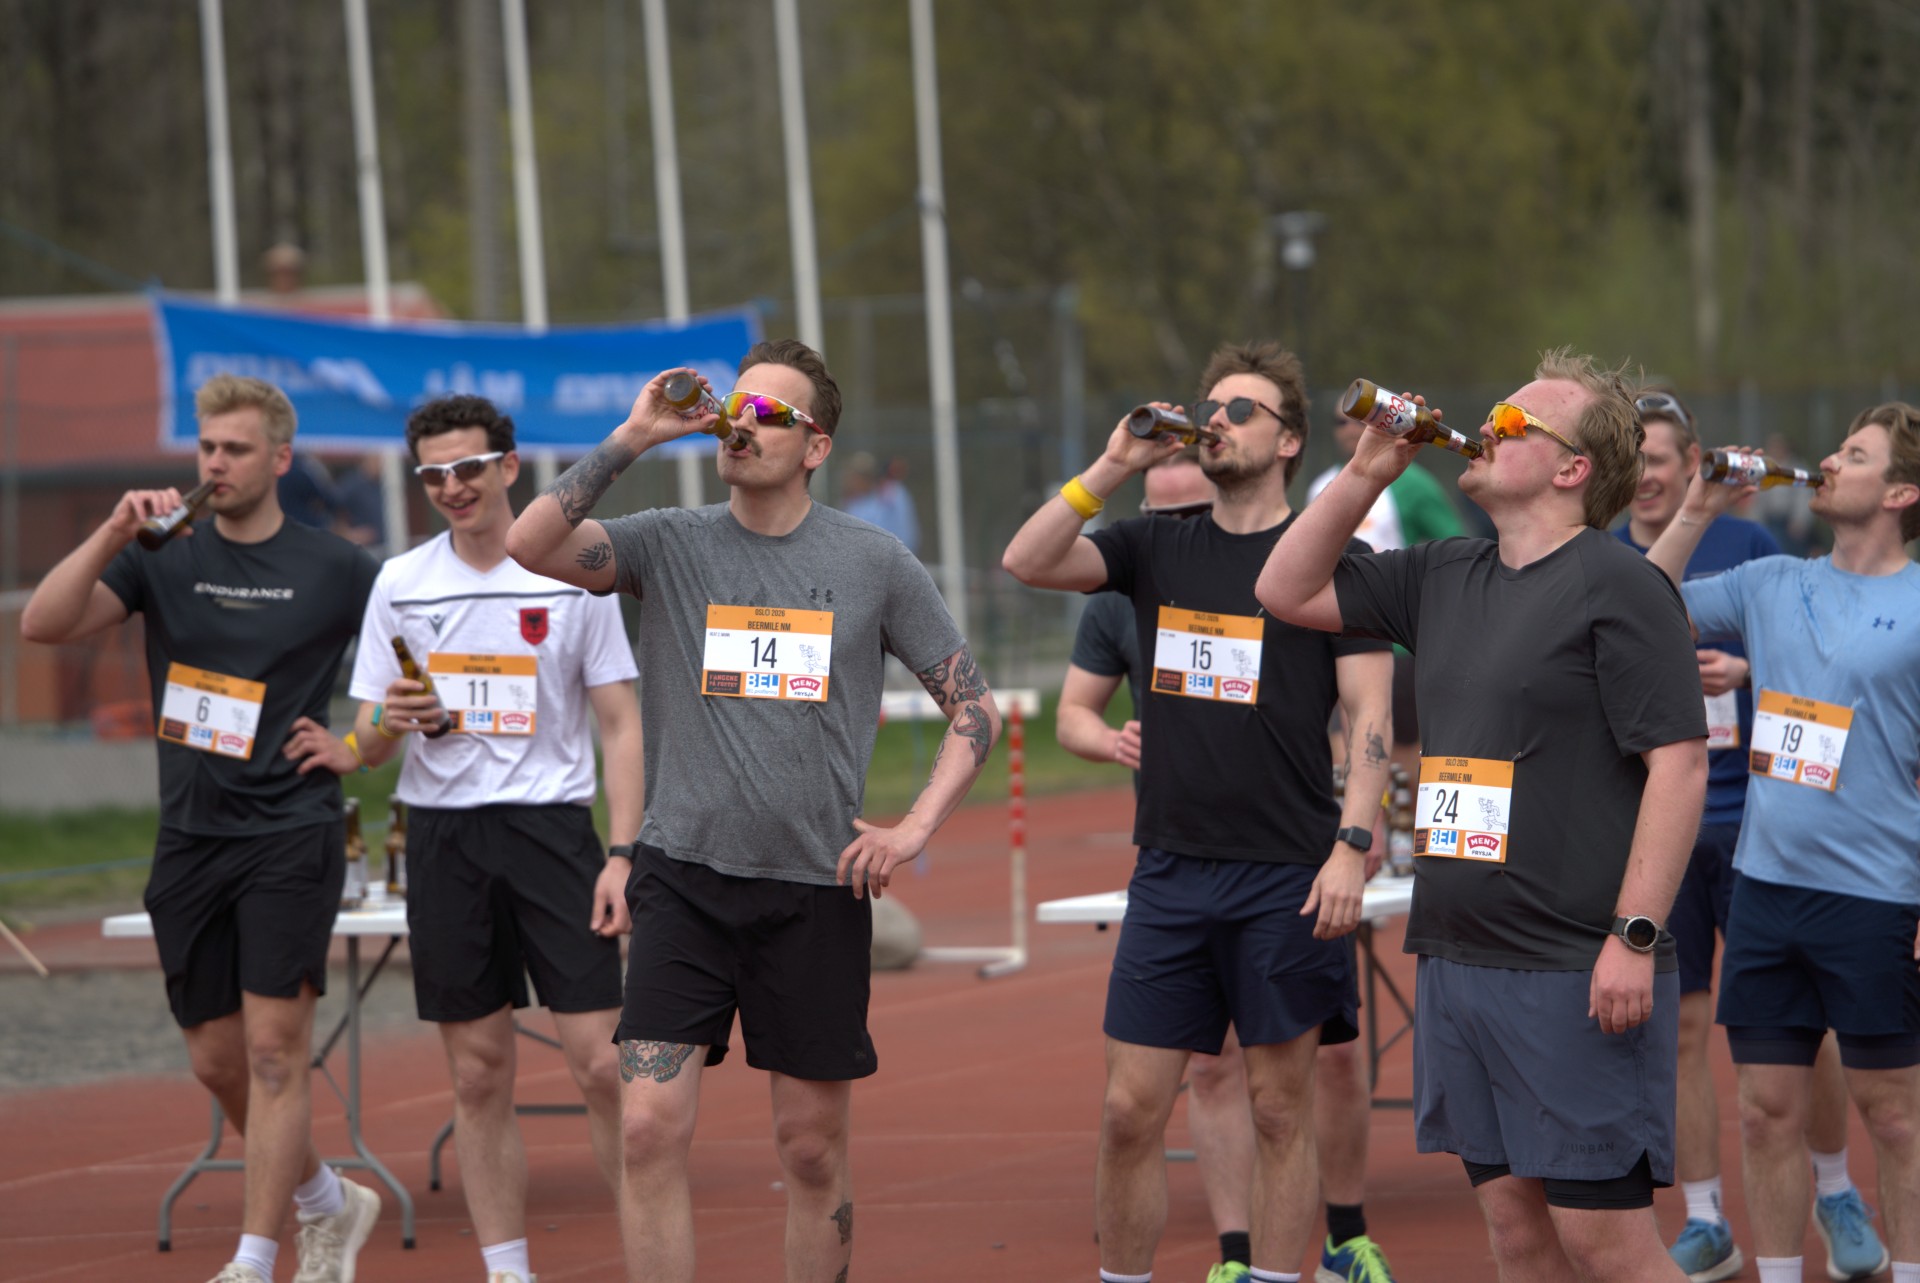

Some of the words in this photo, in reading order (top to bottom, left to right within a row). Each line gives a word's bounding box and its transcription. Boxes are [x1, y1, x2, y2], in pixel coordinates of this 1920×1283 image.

[194, 582, 294, 600] ENDURANCE
[755, 608, 770, 616] OSLO
[771, 609, 785, 617] 2026
[748, 621, 779, 630] BEERMILE
[780, 622, 791, 631] NM
[751, 637, 777, 668] 14
[1190, 640, 1212, 670] 15
[746, 673, 779, 689] BEL
[792, 679, 818, 689] MENY
[1226, 681, 1248, 692] MENY
[468, 680, 488, 706] 11
[196, 696, 211, 722] 6
[1781, 722, 1803, 753] 19
[1439, 772, 1462, 782] BEERMILE
[1463, 774, 1472, 783] NM
[1432, 789, 1459, 824] 24
[1431, 829, 1457, 845] BEL
[1470, 837, 1496, 848] MENY
